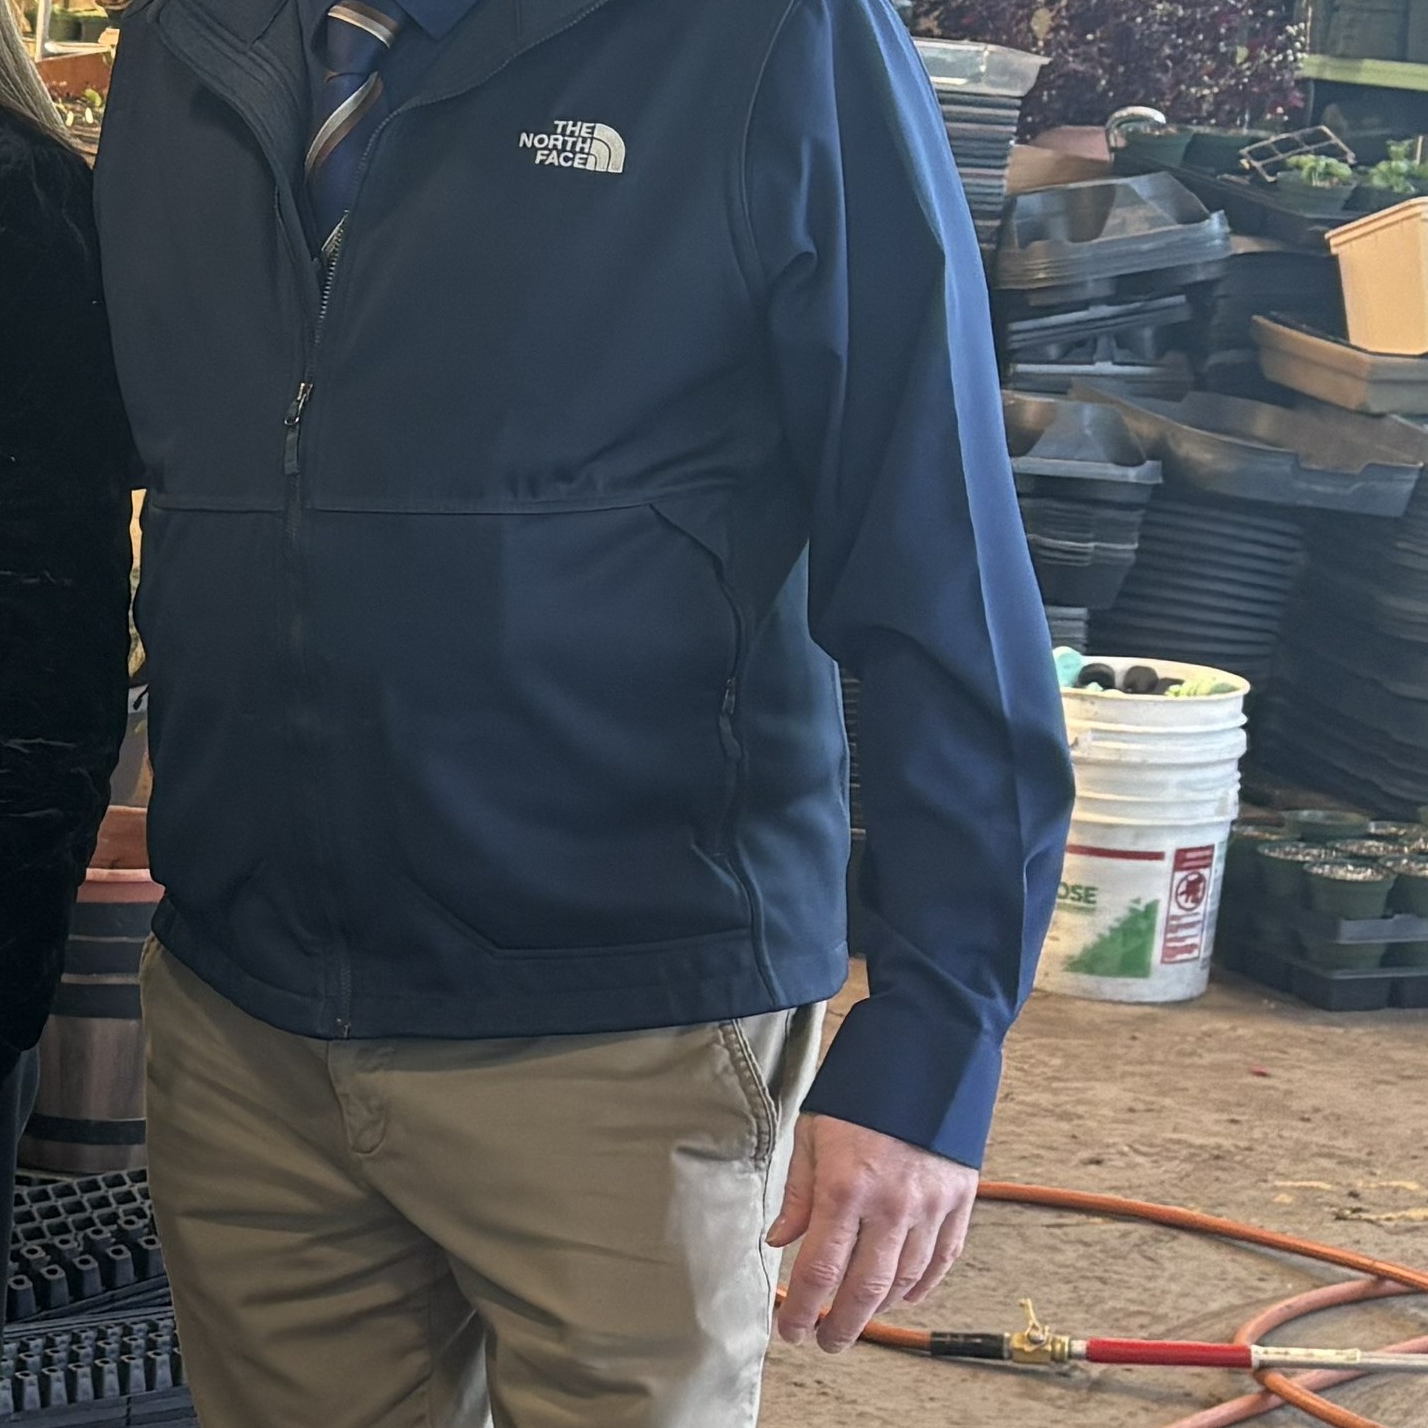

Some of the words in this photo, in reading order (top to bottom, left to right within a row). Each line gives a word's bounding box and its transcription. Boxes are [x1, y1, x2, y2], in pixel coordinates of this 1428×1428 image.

[553, 120, 595, 138] THE
[519, 132, 592, 153] NORTH
[535, 150, 589, 169] FACE
